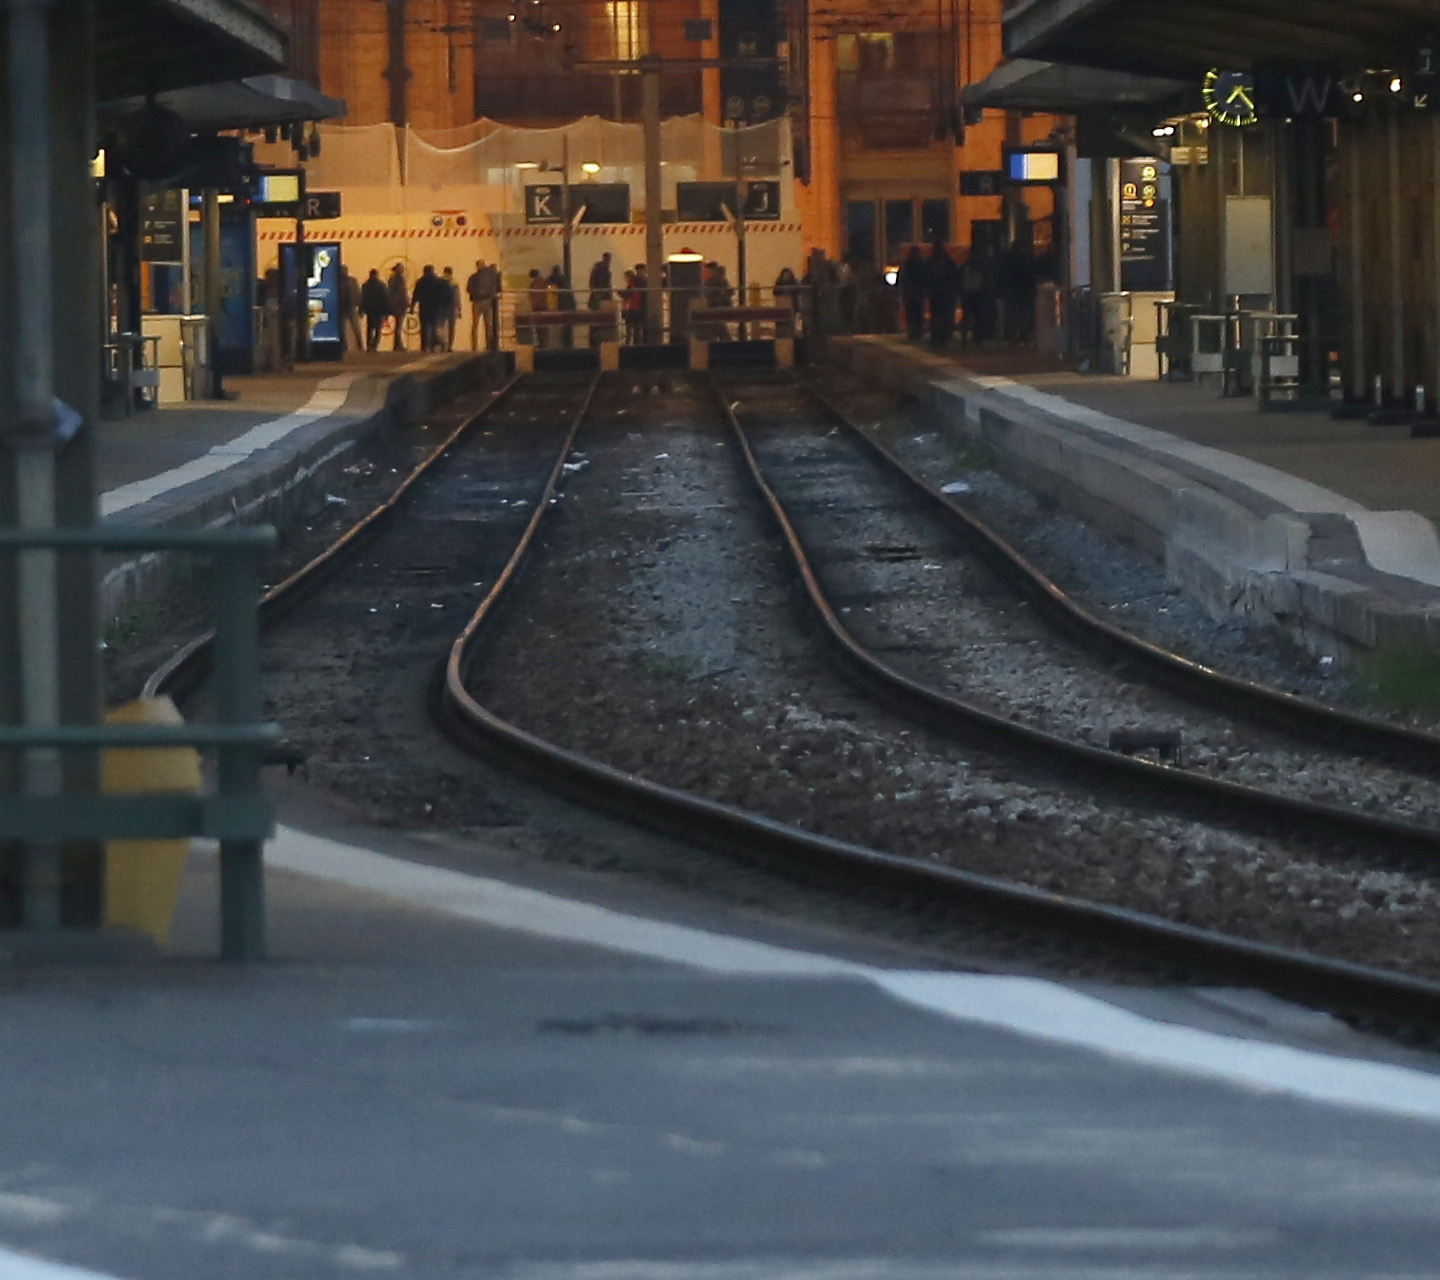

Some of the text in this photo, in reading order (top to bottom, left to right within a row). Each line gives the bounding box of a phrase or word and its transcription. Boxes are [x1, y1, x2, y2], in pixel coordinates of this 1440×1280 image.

[1286, 77, 1331, 113] W
[308, 198, 321, 215] R
[533, 195, 554, 217] K
